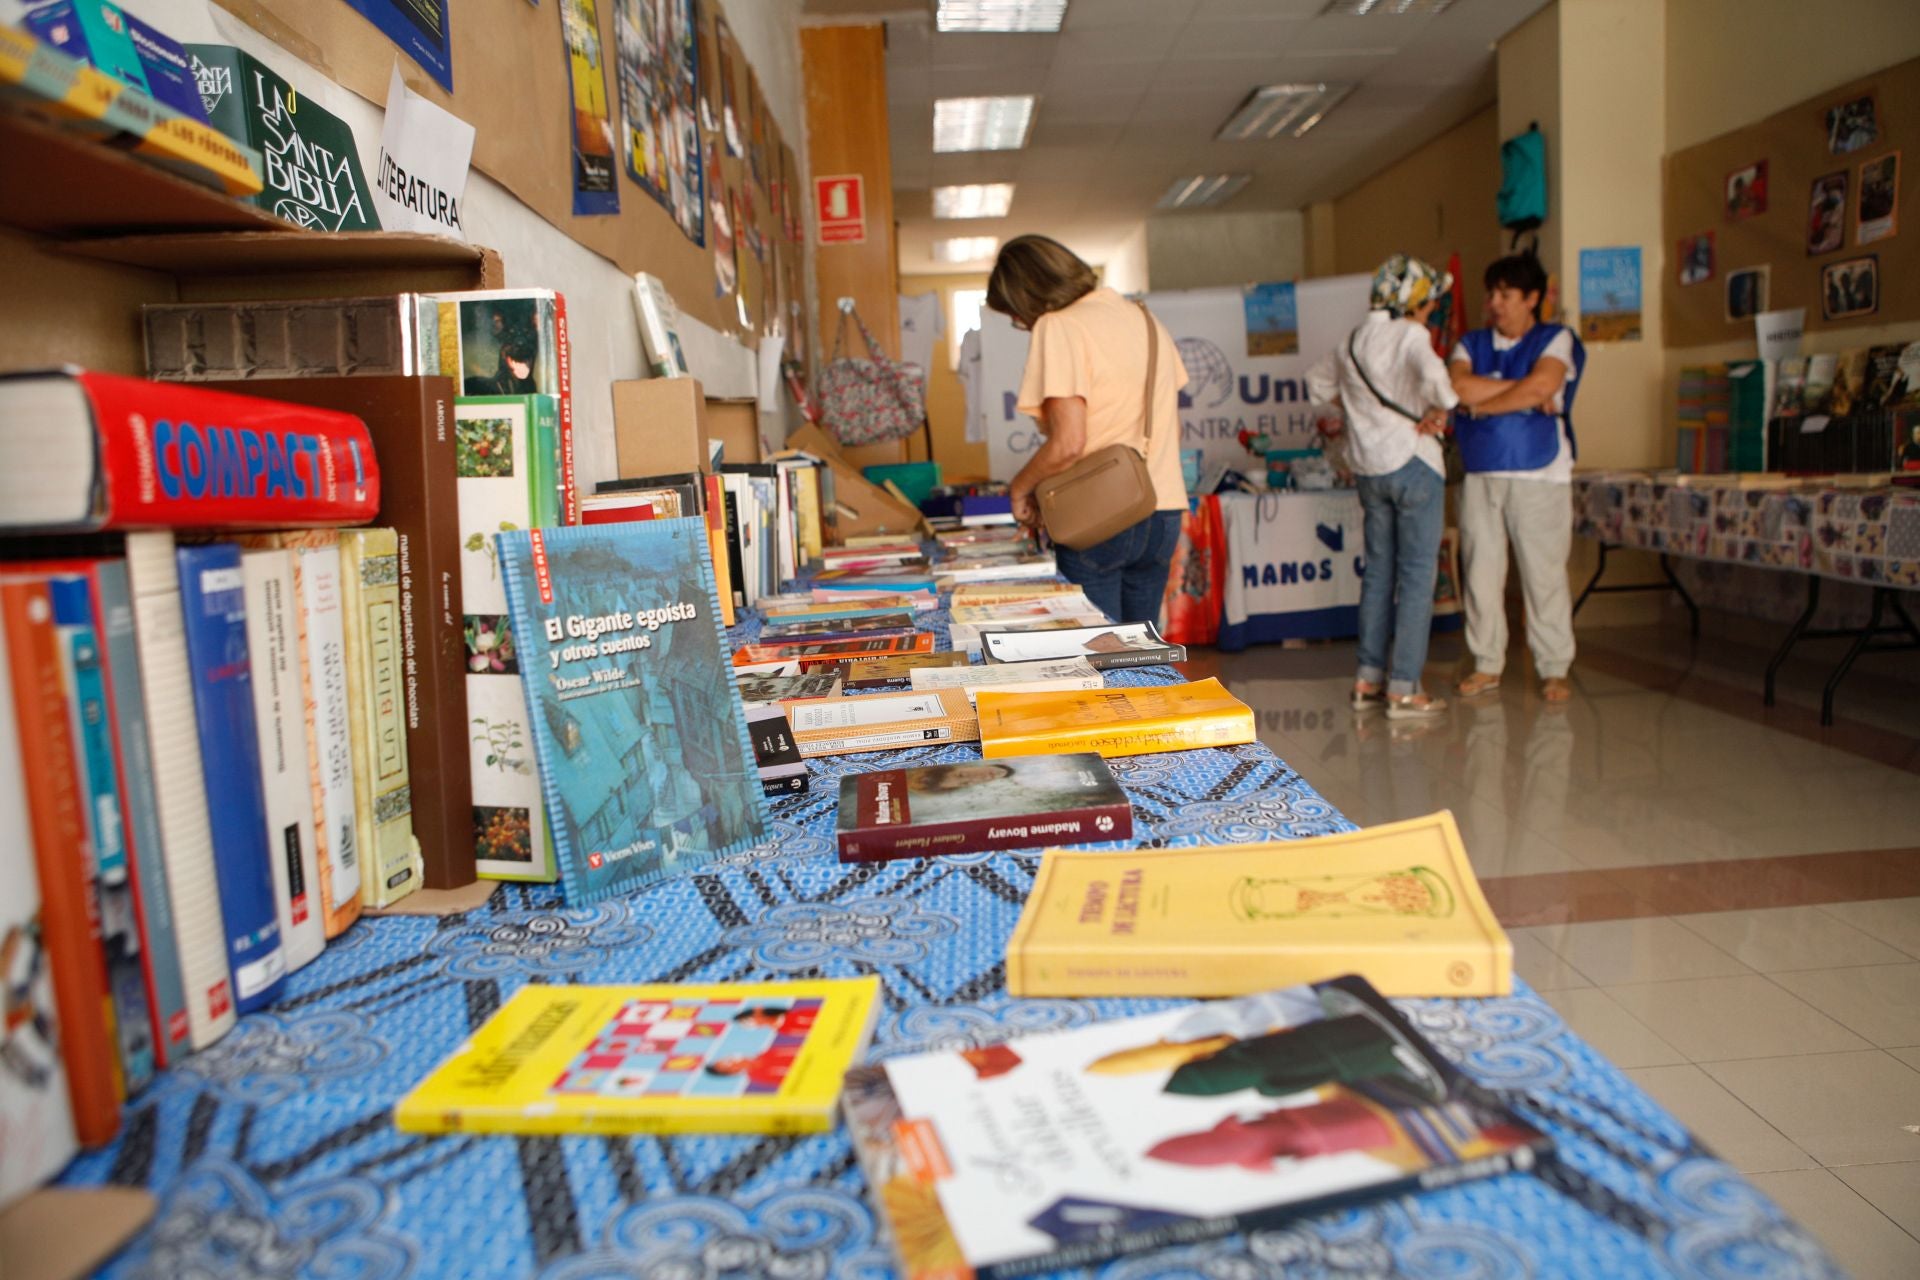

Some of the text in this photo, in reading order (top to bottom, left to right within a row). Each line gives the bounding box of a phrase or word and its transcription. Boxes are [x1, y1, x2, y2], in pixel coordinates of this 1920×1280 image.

[254, 70, 297, 131] LA
[263, 114, 356, 191] SANTA
[265, 147, 367, 227] BIBLIA
[377, 147, 463, 231] LITERATURA
[558, 317, 570, 392] PERROS
[436, 400, 446, 442] LAROUSSE
[562, 398, 573, 423] DE
[1257, 413, 1281, 436] EL
[154, 419, 320, 500] COMPACT
[318, 433, 337, 503] DICTIONARY
[400, 534, 410, 578] manual
[1241, 558, 1333, 588] MANOS
[402, 580, 411, 590] de
[402, 592, 415, 655] degustación
[544, 601, 697, 642] El Gigante egoísta
[551, 632, 652, 669] y otros cuentos
[375, 615, 398, 763] LA BIBLIA
[554, 668, 627, 692] Oscar Wilde
[409, 676, 420, 729] chocolate
[1090, 736, 1119, 749] deseo
[895, 820, 1081, 848] Madame Bovary Gustave Flaubert
